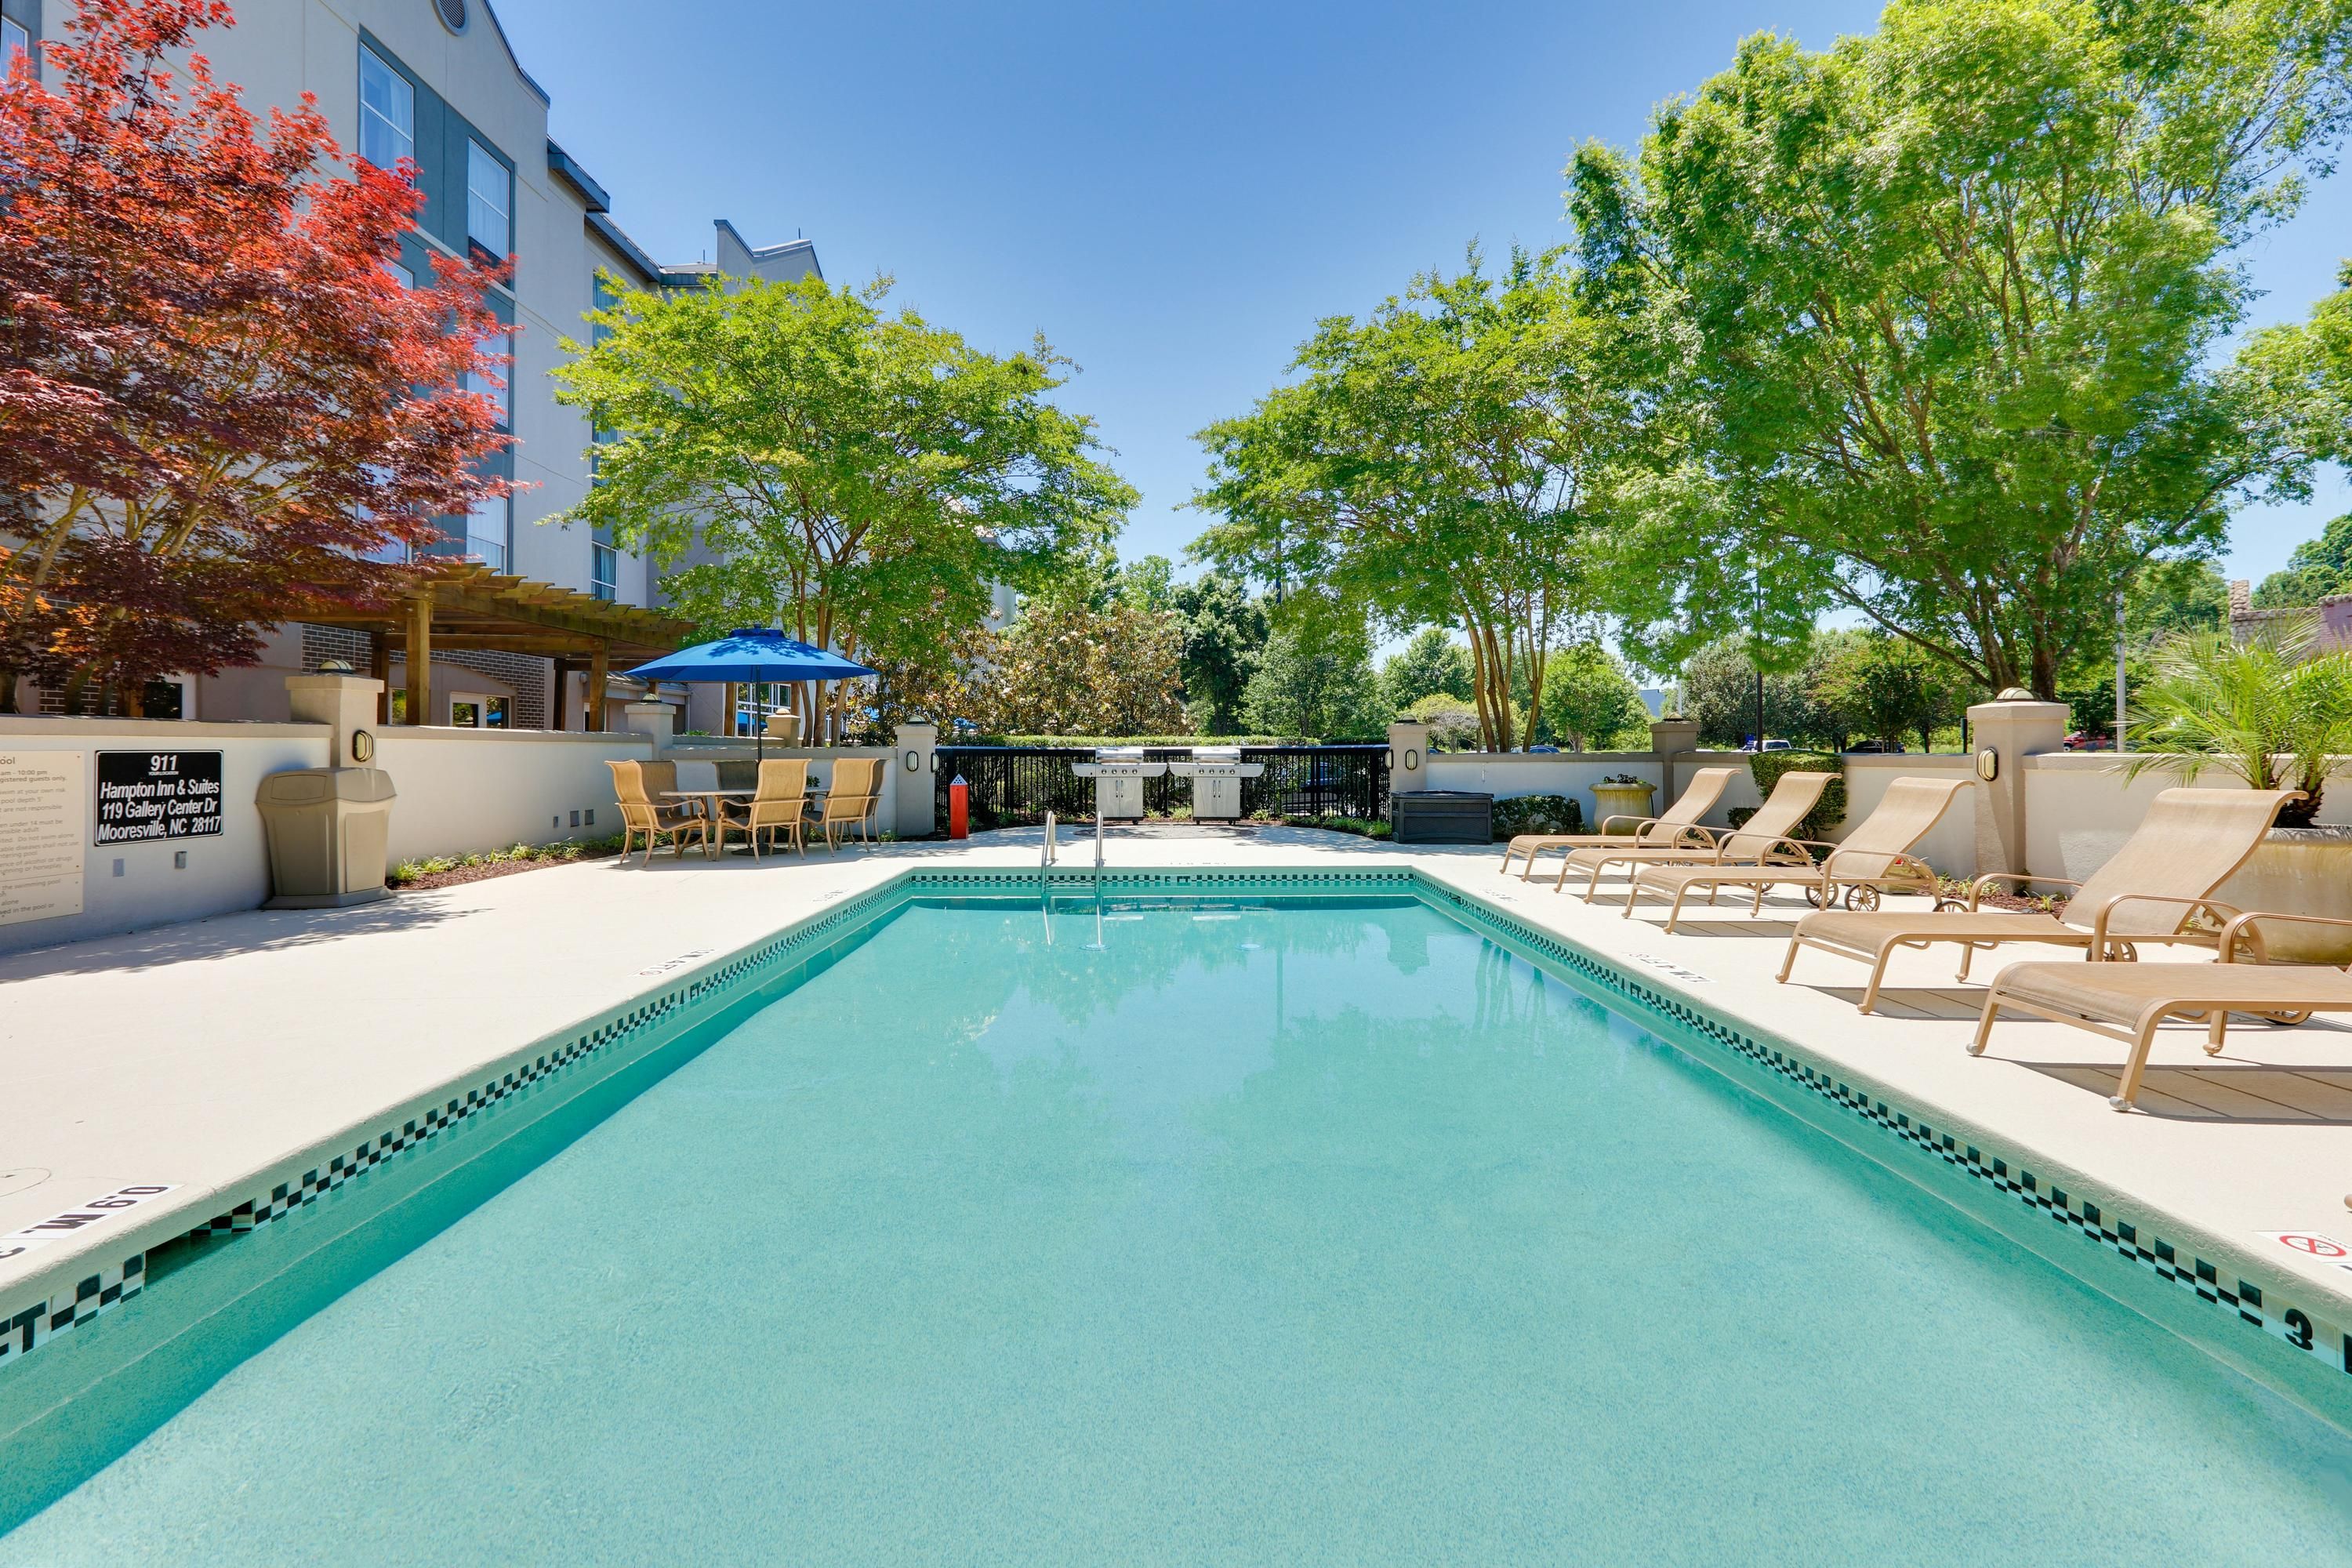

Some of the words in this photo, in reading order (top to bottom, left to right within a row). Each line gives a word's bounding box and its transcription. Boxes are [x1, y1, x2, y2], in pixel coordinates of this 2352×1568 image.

[150, 755, 178, 771] 911
[100, 781, 155, 801] Hampton
[157, 780, 175, 797] Inn
[176, 779, 186, 796] &
[187, 779, 220, 795] Suites
[102, 802, 123, 819] 119
[125, 800, 166, 820] Gallery
[167, 799, 204, 815] Center
[204, 797, 218, 813] Dr
[98, 820, 168, 841] Mooresville,
[169, 818, 188, 835] NC
[191, 815, 221, 833] 28117
